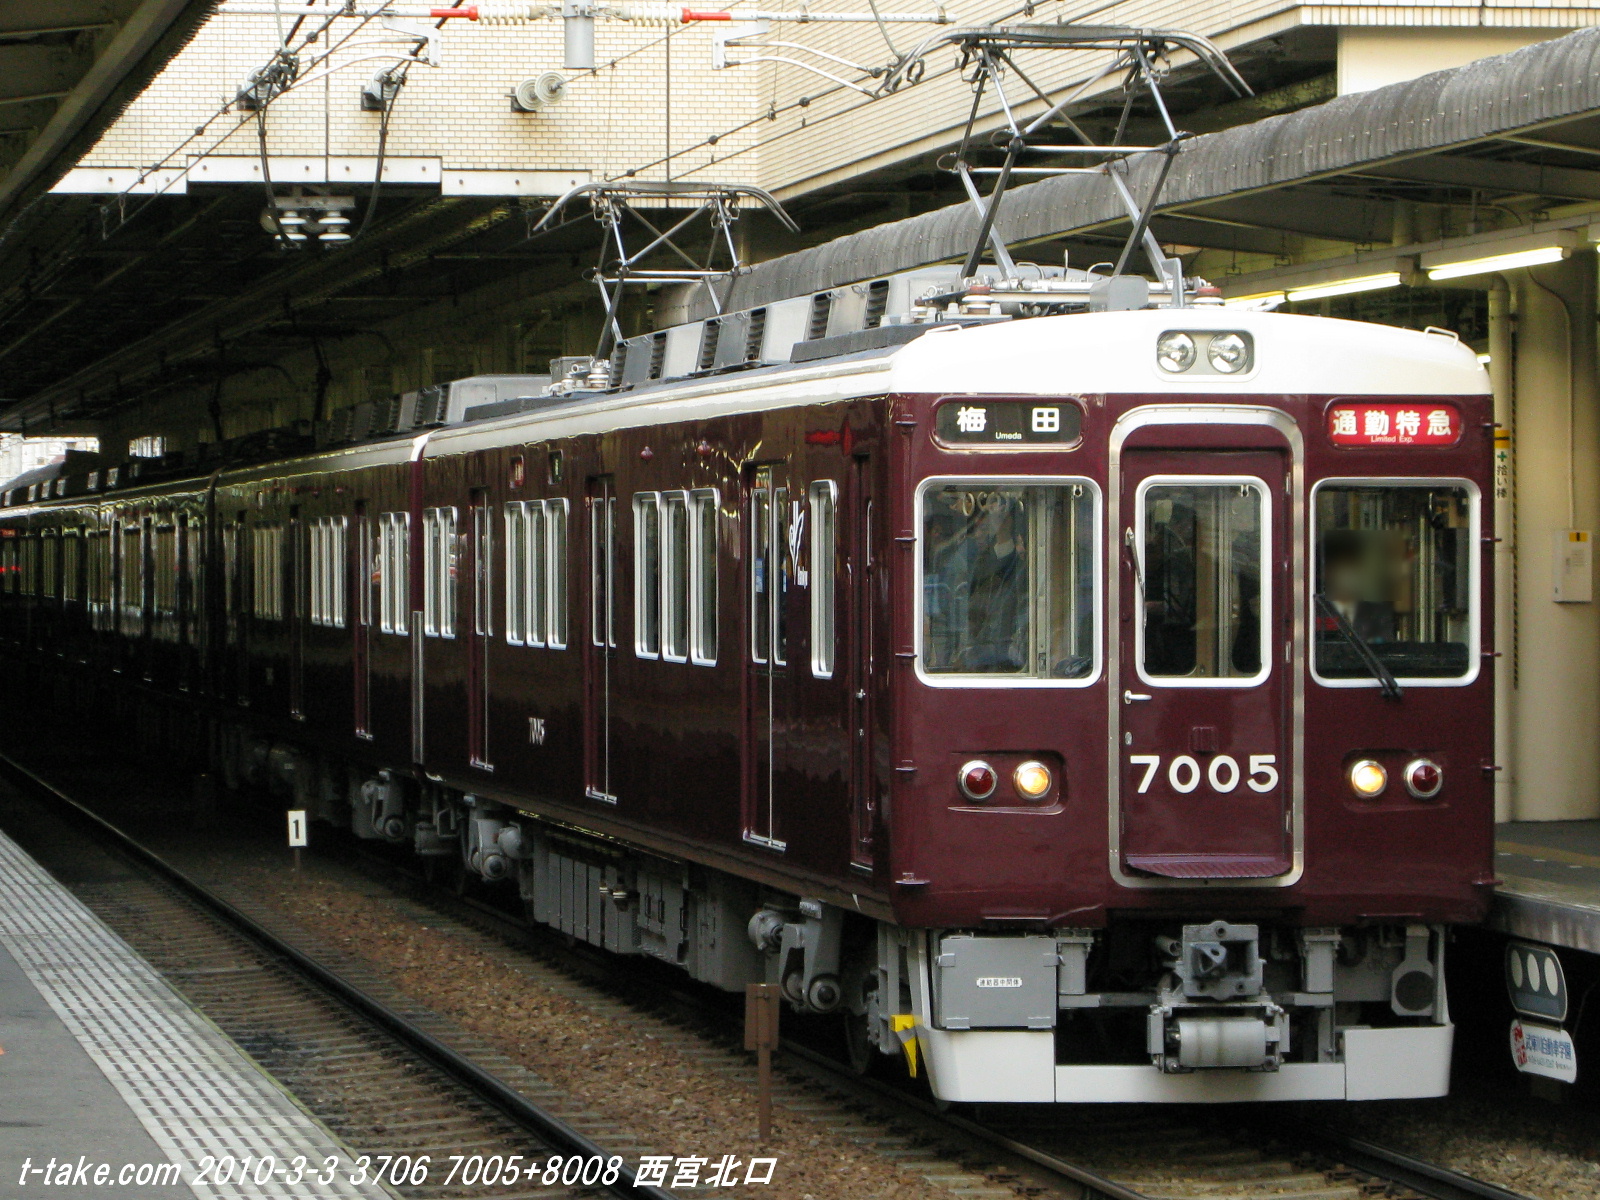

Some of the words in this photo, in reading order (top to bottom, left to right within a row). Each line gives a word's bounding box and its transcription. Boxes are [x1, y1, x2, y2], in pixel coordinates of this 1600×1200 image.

[957, 406, 1060, 433] 梅田
[1332, 409, 1452, 436] 通勤特急
[995, 431, 1023, 440] Umeda
[1370, 435, 1396, 443] Limited
[1399, 435, 1415, 444] Exp.
[1130, 754, 1279, 794] 7005
[292, 819, 300, 840] 1
